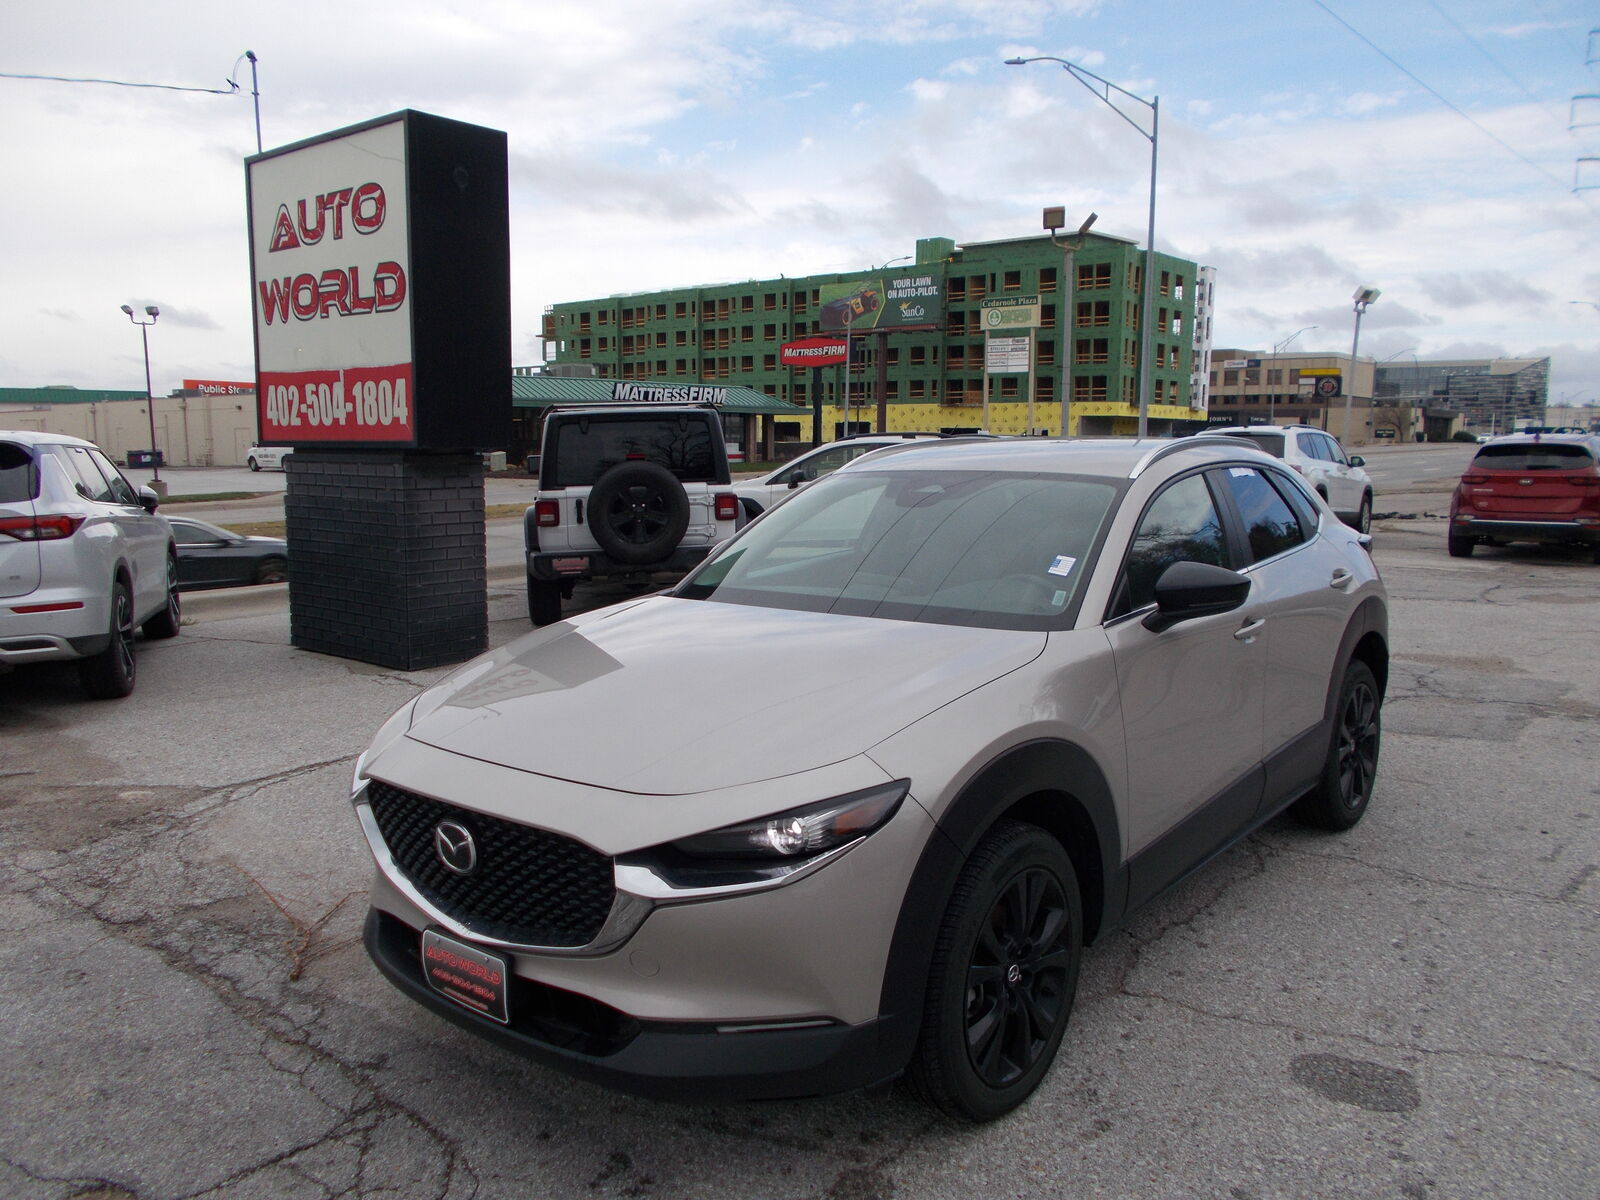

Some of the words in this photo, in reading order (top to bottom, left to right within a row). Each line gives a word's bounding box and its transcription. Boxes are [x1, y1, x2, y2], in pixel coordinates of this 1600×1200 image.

[269, 182, 386, 253] AUTO
[893, 279, 911, 289] YOUR
[911, 276, 932, 288] LAWN
[258, 261, 407, 326] WORLD
[887, 289, 898, 299] ON
[898, 286, 938, 298] AUTO-PILOT.
[1018, 297, 1037, 305] Plaza
[901, 305, 925, 318] SunCo
[198, 384, 226, 394] Public
[266, 378, 409, 427] 402-504-1804
[427, 946, 457, 966] AUTO
[460, 960, 501, 984] WORLD
